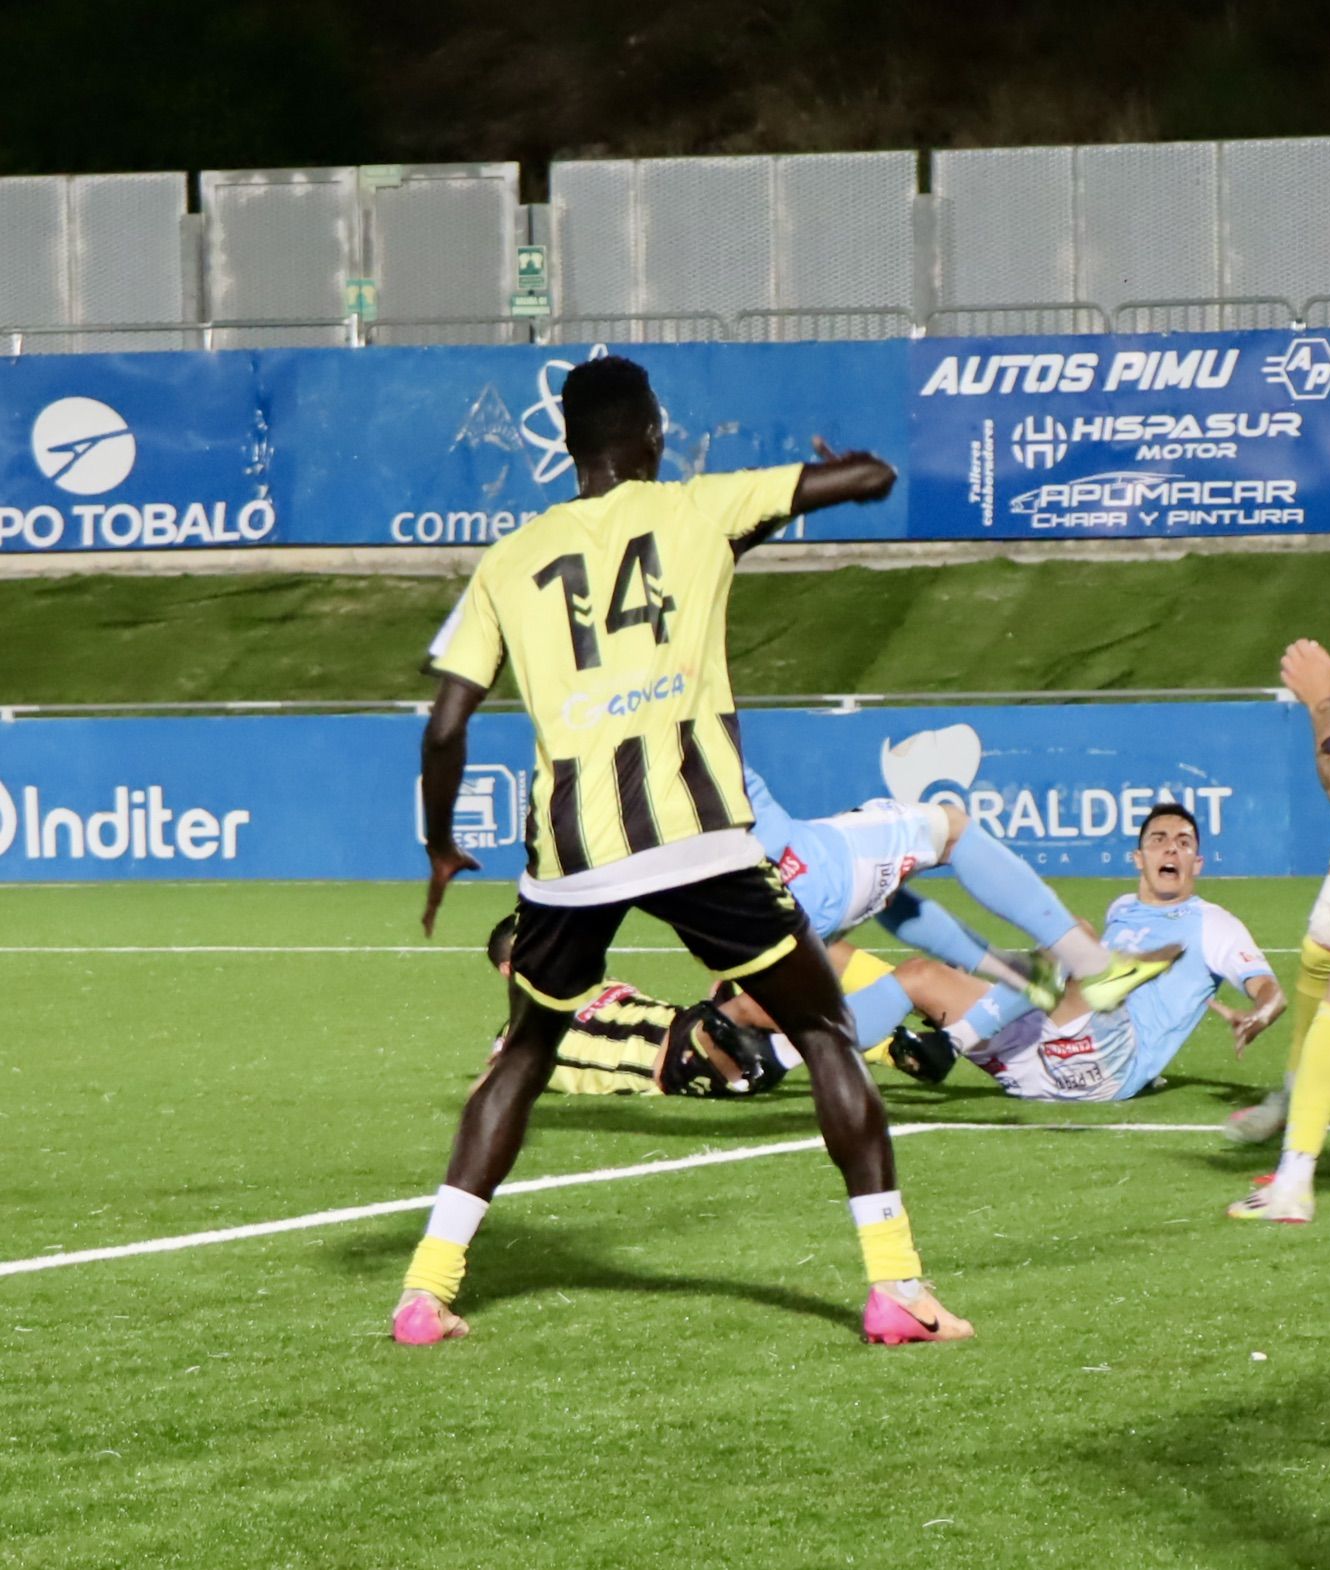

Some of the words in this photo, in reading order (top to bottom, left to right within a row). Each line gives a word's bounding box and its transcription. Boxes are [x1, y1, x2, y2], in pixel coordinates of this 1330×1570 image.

[920, 353, 1099, 396] AUTOS
[1103, 349, 1240, 392] PIMU
[1071, 412, 1302, 442] HISPASUR
[1135, 442, 1238, 460] MOTOR
[968, 440, 981, 503] Talleres
[981, 418, 994, 526] colaboradores
[1036, 480, 1298, 509] APUMACAR
[1032, 511, 1127, 528] CHAPA
[1139, 511, 1161, 526] Y
[1167, 508, 1305, 526] PINTURA
[531, 531, 678, 672] 14
[24, 785, 250, 859] Inditer
[452, 832, 498, 849] ESIL
